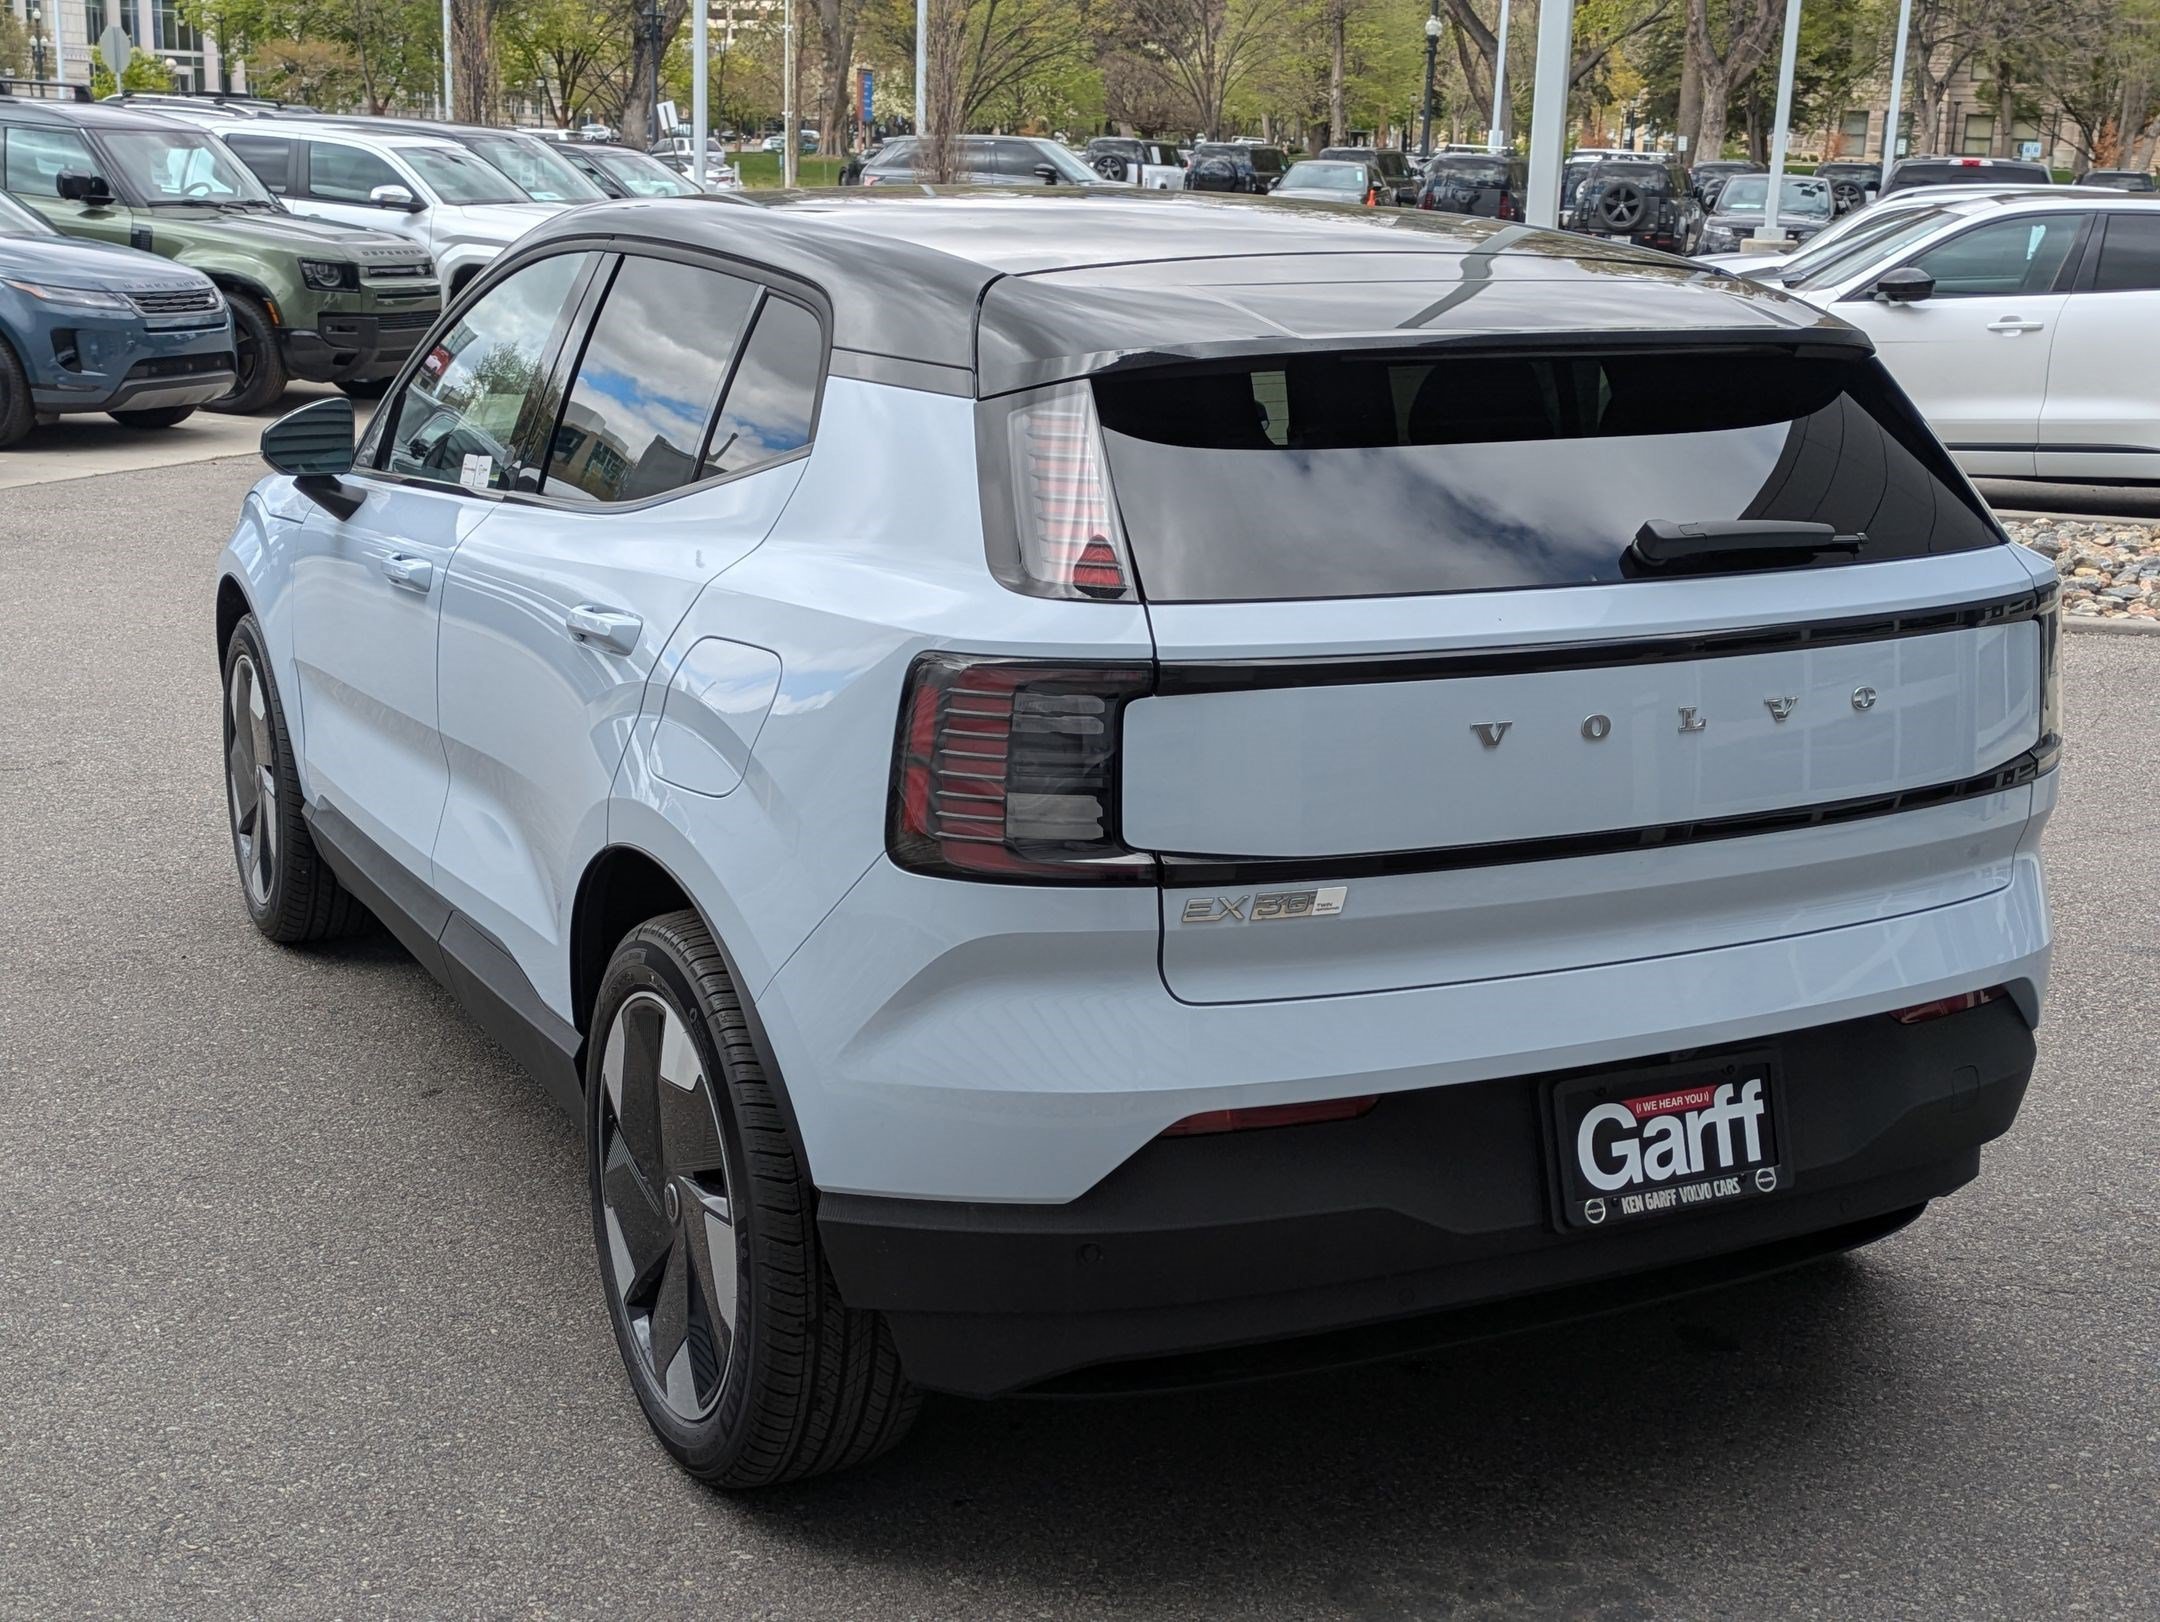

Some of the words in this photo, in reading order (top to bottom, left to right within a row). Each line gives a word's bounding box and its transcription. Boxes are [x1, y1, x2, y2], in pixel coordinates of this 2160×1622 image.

[1470, 685, 1877, 746] VOLVO
[1643, 1100, 1658, 1112] WE
[1659, 1096, 1683, 1109] HEAR
[1684, 1093, 1703, 1105] YOU
[1577, 1078, 1765, 1191] Garff
[1621, 1194, 1644, 1215] KEN
[1645, 1188, 1676, 1210] GARFF
[1679, 1182, 1713, 1204] VOLVO
[1713, 1176, 1741, 1198] CARS
